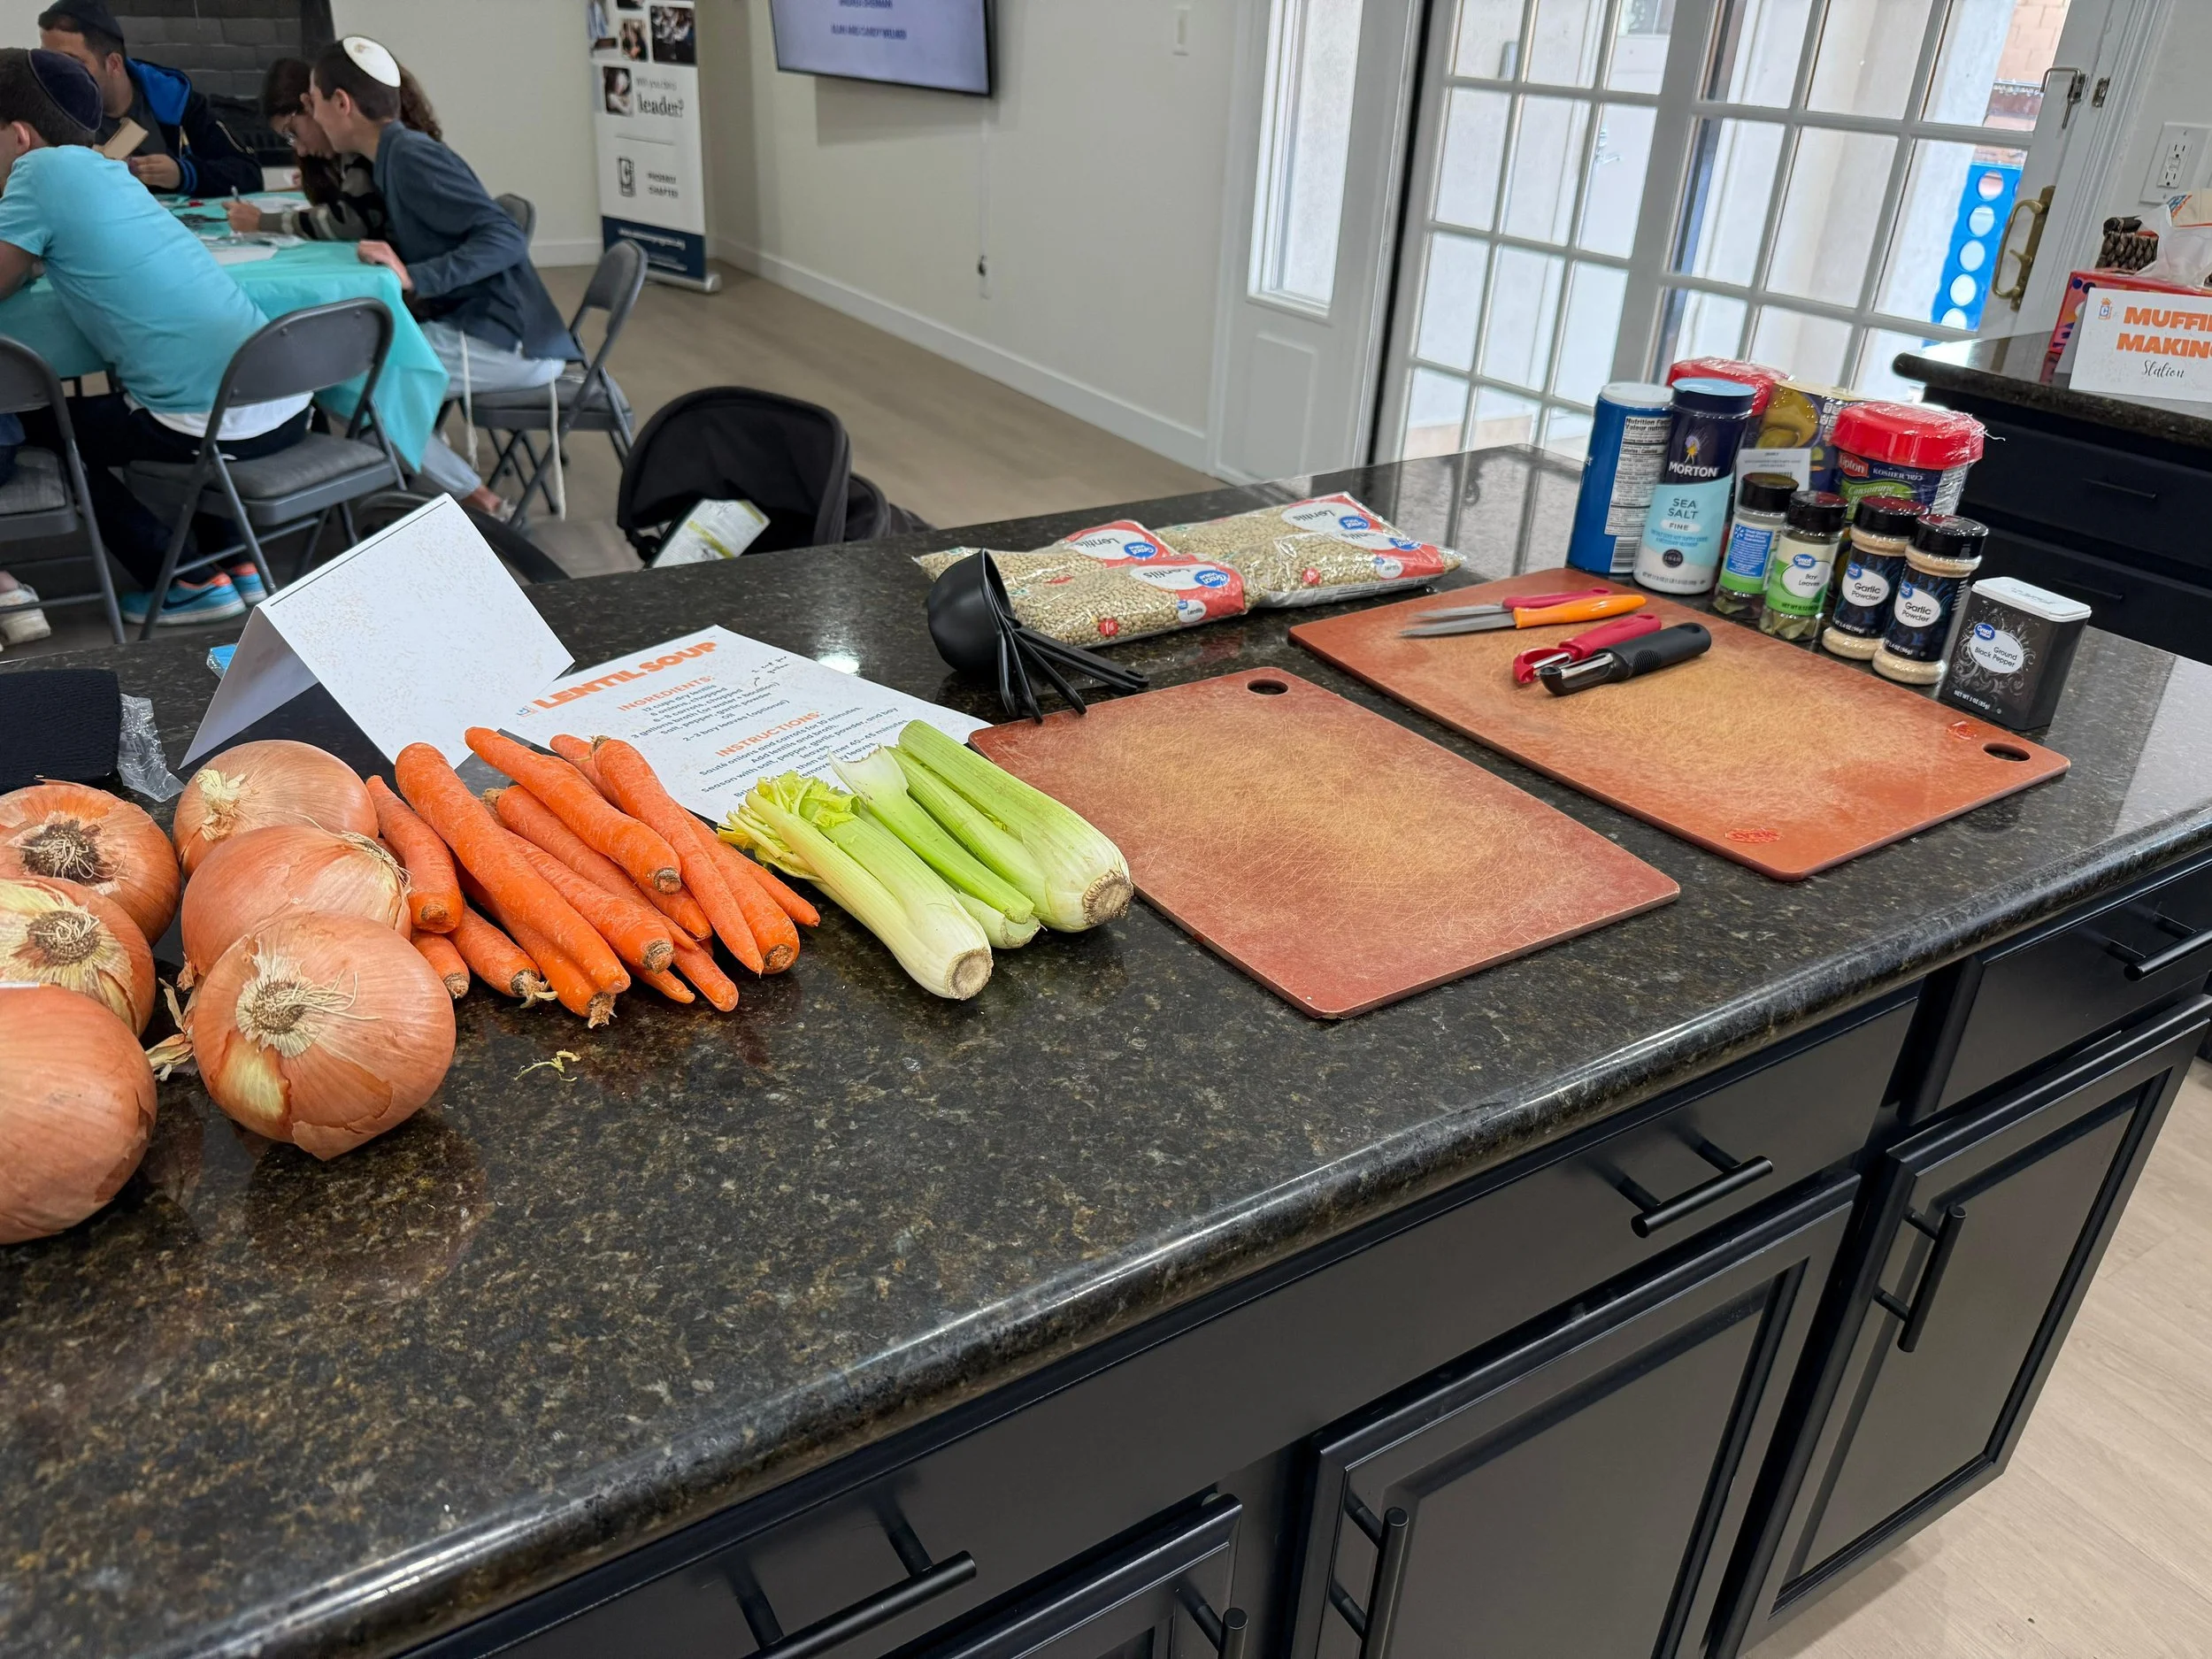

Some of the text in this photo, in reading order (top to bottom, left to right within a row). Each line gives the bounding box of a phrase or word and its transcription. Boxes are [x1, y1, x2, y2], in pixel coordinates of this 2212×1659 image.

[637, 91, 685, 118] leader?
[2124, 306, 2212, 332] MUFFI
[2116, 333, 2212, 359] MAKIN
[2143, 358, 2185, 379] Station
[1669, 461, 1718, 478] MORTON
[1840, 455, 1865, 474] Lipton
[1873, 468, 1904, 480] KOSHER
[1668, 508, 1699, 519] SALT
[1672, 498, 1697, 509] SEA
[1293, 510, 1335, 521] Lentils
[1077, 537, 1120, 549] Lentils
[1130, 546, 1155, 555] Great
[1202, 574, 1227, 584] Great
[1855, 583, 1881, 595] Garlic
[1852, 591, 1879, 601] Powder
[1902, 611, 1930, 622] Powder
[1905, 603, 1932, 615] Garlic
[1977, 626, 1992, 635] Great
[1974, 647, 2016, 668] Black Pepper
[1993, 646, 2018, 661] Ground
[532, 641, 718, 710] LENTIL SOUP
[618, 675, 716, 712] INGREDIENTS:
[653, 696, 675, 710] cups
[675, 692, 691, 703] dry
[689, 684, 718, 696] lentils
[658, 700, 691, 715] onions,
[690, 687, 728, 703] chopped
[672, 702, 708, 718] carrots,
[707, 688, 744, 707] chopped
[1954, 689, 1962, 698] NET
[639, 720, 674, 738] gallons
[673, 711, 699, 725] broth
[697, 706, 711, 716] (or
[710, 697, 738, 710] water
[660, 692, 772, 736] Salt, pepper, garlic powder
[682, 699, 791, 742] 2-3 bay leaves (optional)
[699, 763, 729, 777] Sauté
[727, 749, 759, 765] onions
[757, 741, 776, 752] and
[775, 728, 807, 745] carrots
[805, 723, 819, 733] for
[827, 707, 864, 723] minutes.
[714, 710, 825, 758] INSTRUCTIONS:
[750, 724, 840, 764] Add lentils and broth.
[701, 776, 738, 793] Season
[736, 766, 759, 780] with
[757, 758, 780, 771] salt,
[777, 744, 811, 763] pepper,
[810, 734, 835, 747] garlic
[835, 720, 867, 736] powder,
[866, 713, 884, 722] and
[796, 760, 818, 772] then
[849, 731, 877, 748] 40-45
[799, 744, 833, 759] leaves.
